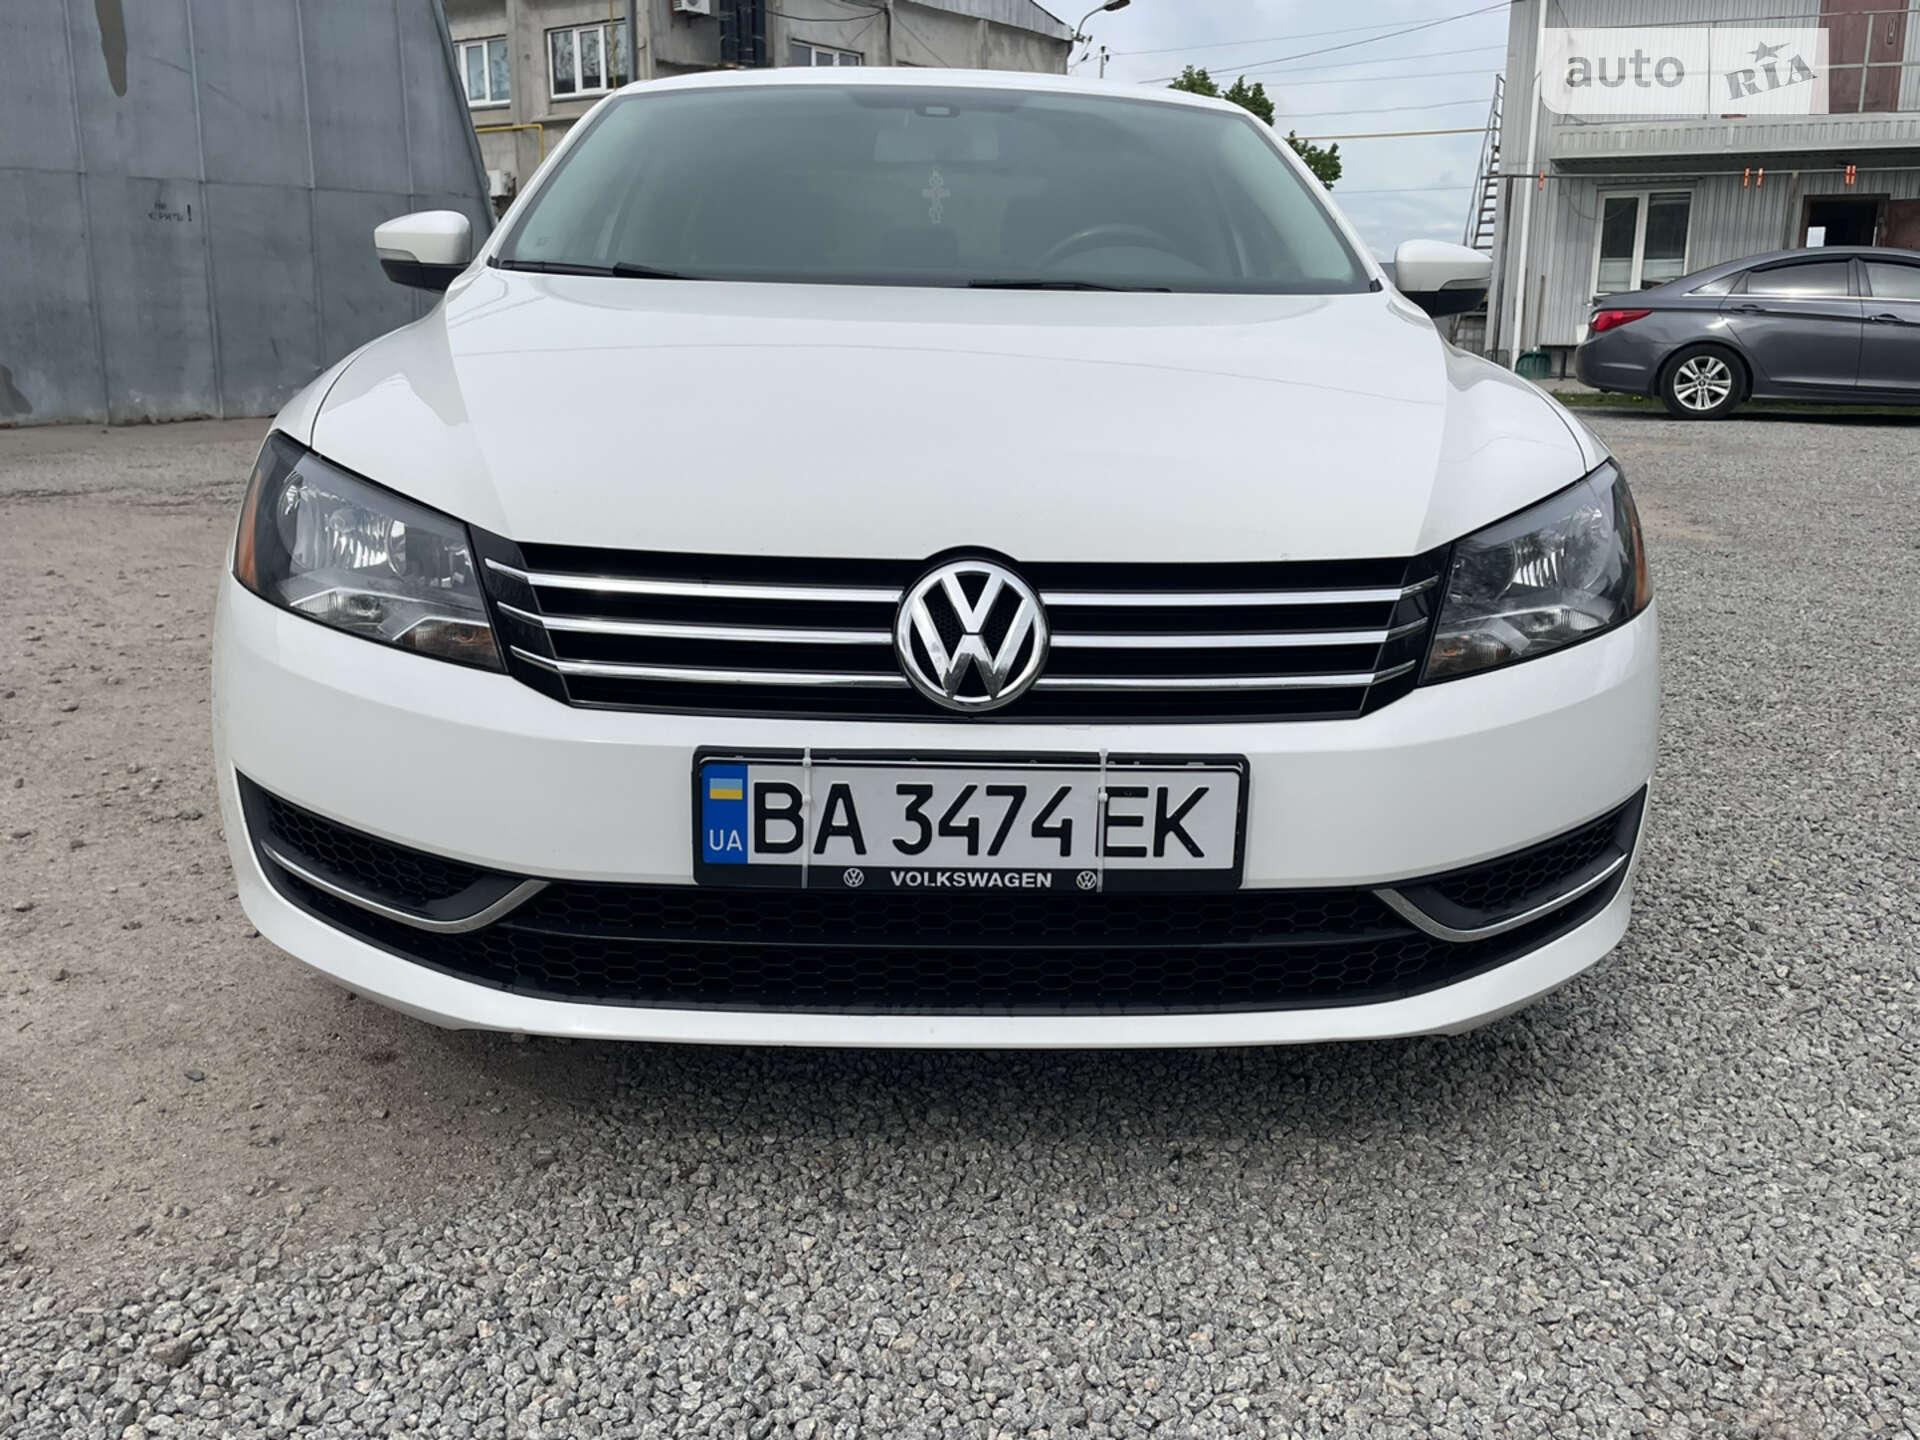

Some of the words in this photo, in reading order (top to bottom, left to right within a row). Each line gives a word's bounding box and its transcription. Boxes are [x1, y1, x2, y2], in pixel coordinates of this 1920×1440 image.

[754, 782, 867, 855] BA
[893, 784, 1073, 857] 3474
[1095, 786, 1210, 858] EK
[709, 829, 743, 851] UA
[890, 871, 1052, 888] VOLKSWAGEN
